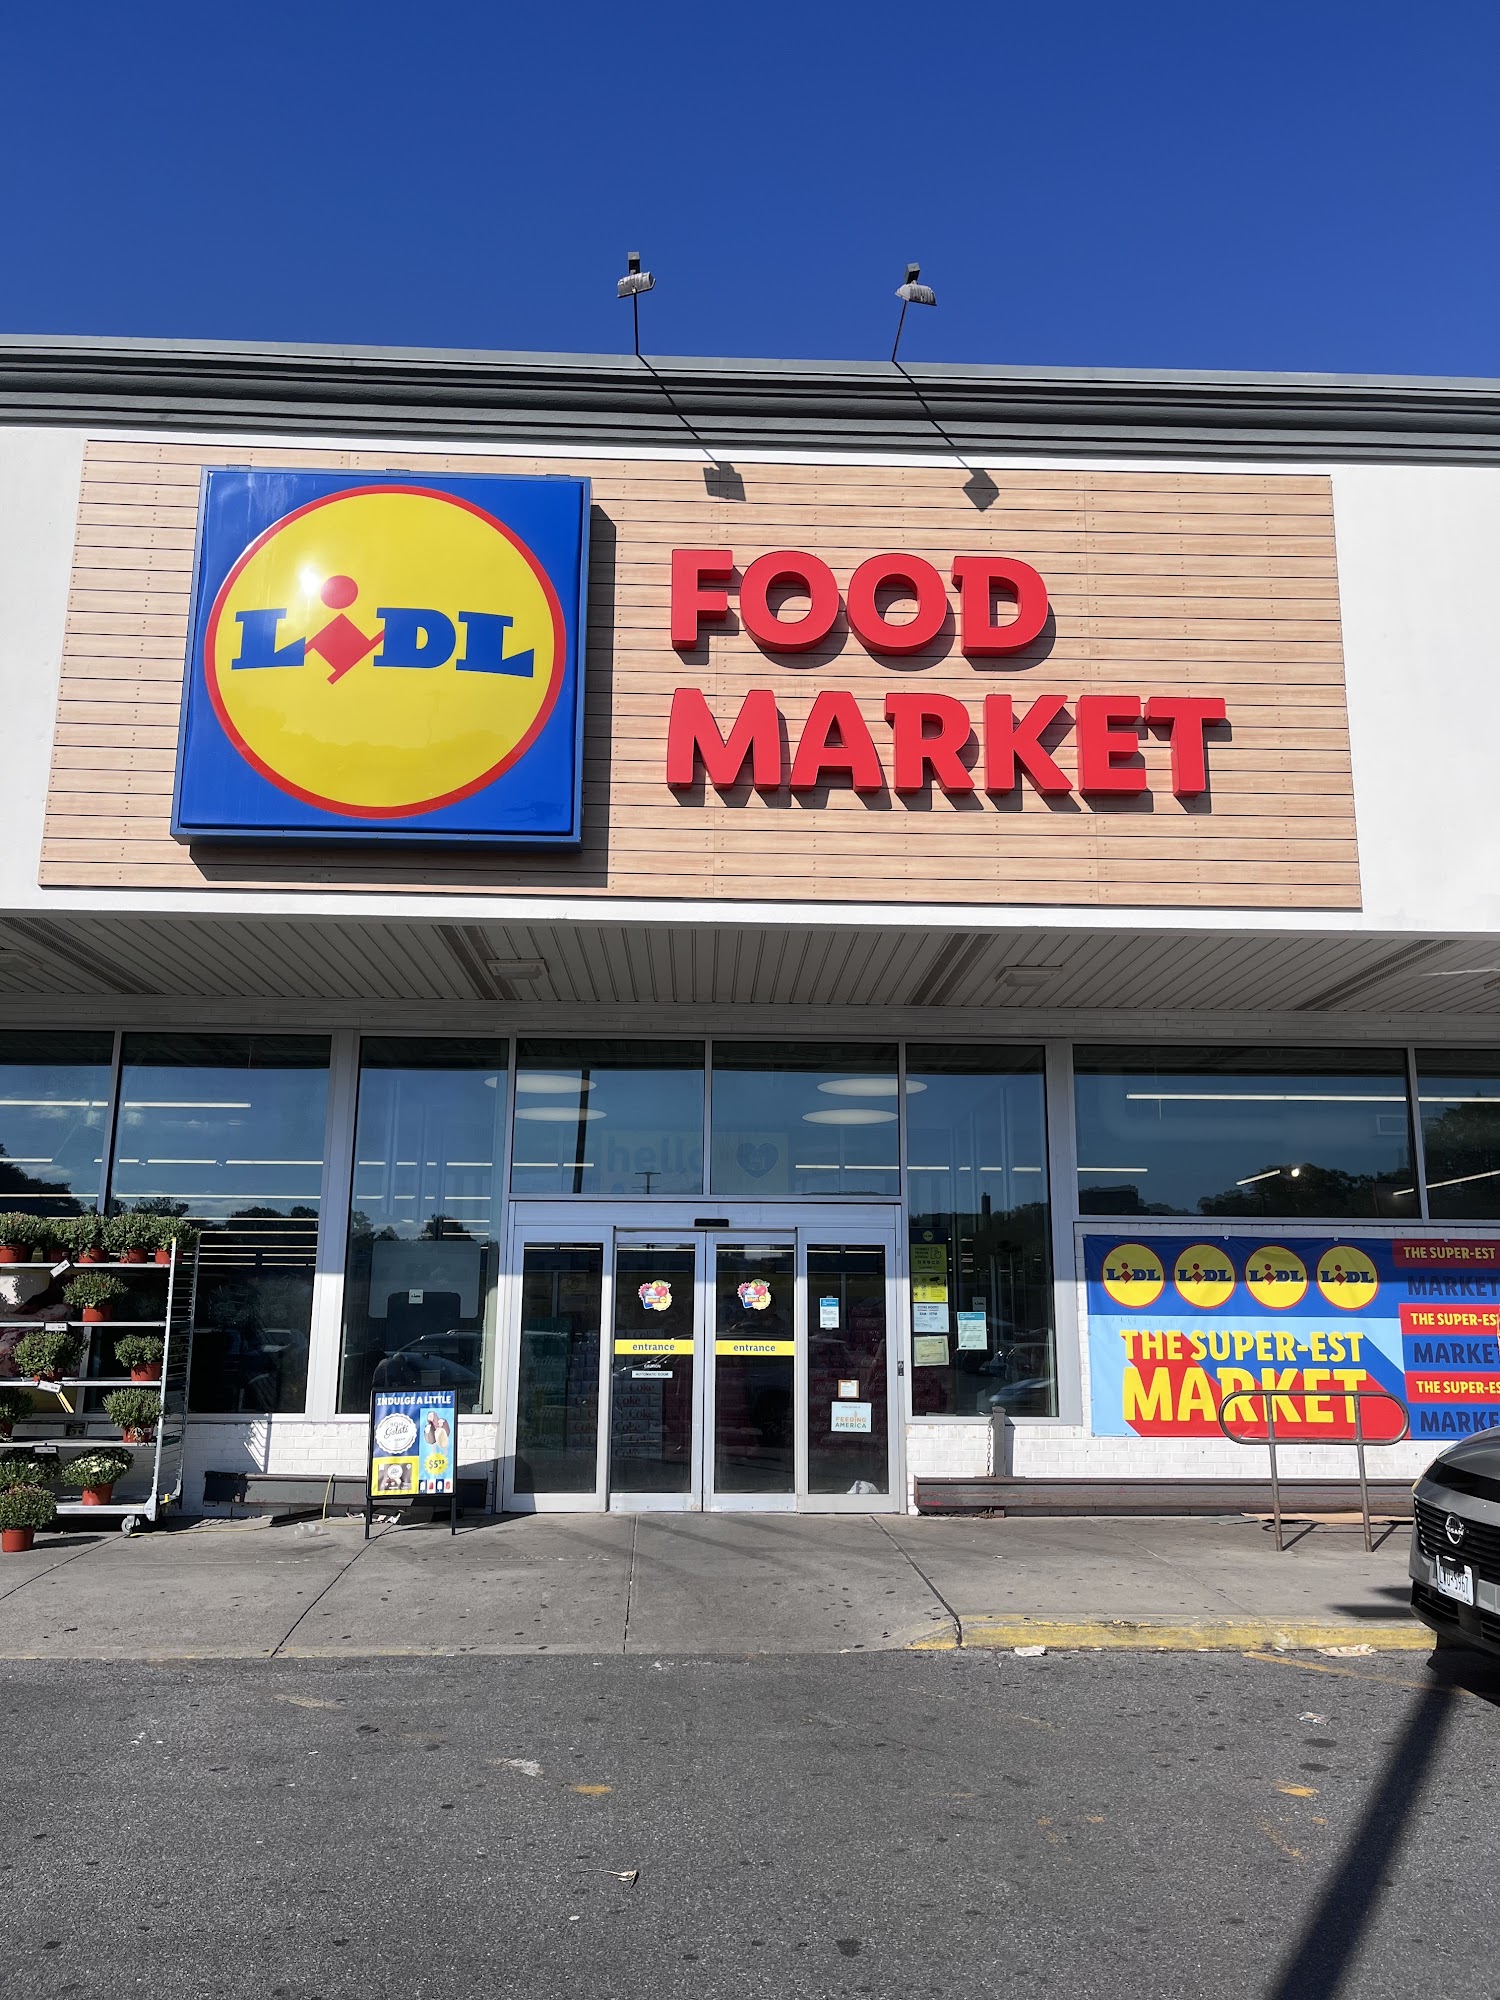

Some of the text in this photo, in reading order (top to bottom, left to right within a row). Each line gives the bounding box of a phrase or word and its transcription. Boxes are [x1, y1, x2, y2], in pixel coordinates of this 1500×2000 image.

[671, 549, 1049, 655] FOOD
[667, 688, 1226, 798] MARKET
[1403, 1246, 1496, 1259] THE SUPER-EST
[1407, 1275, 1499, 1296] MARKET
[1410, 1312, 1498, 1326] THE SUPER-ES
[632, 1342, 675, 1351] entrance
[733, 1343, 776, 1352] entrance
[1120, 1330, 1364, 1362] THE SUPER-EST
[1416, 1381, 1441, 1393] THE
[377, 1396, 452, 1406] INDULGE A LITTLE
[1122, 1367, 1367, 1423] MARKET
